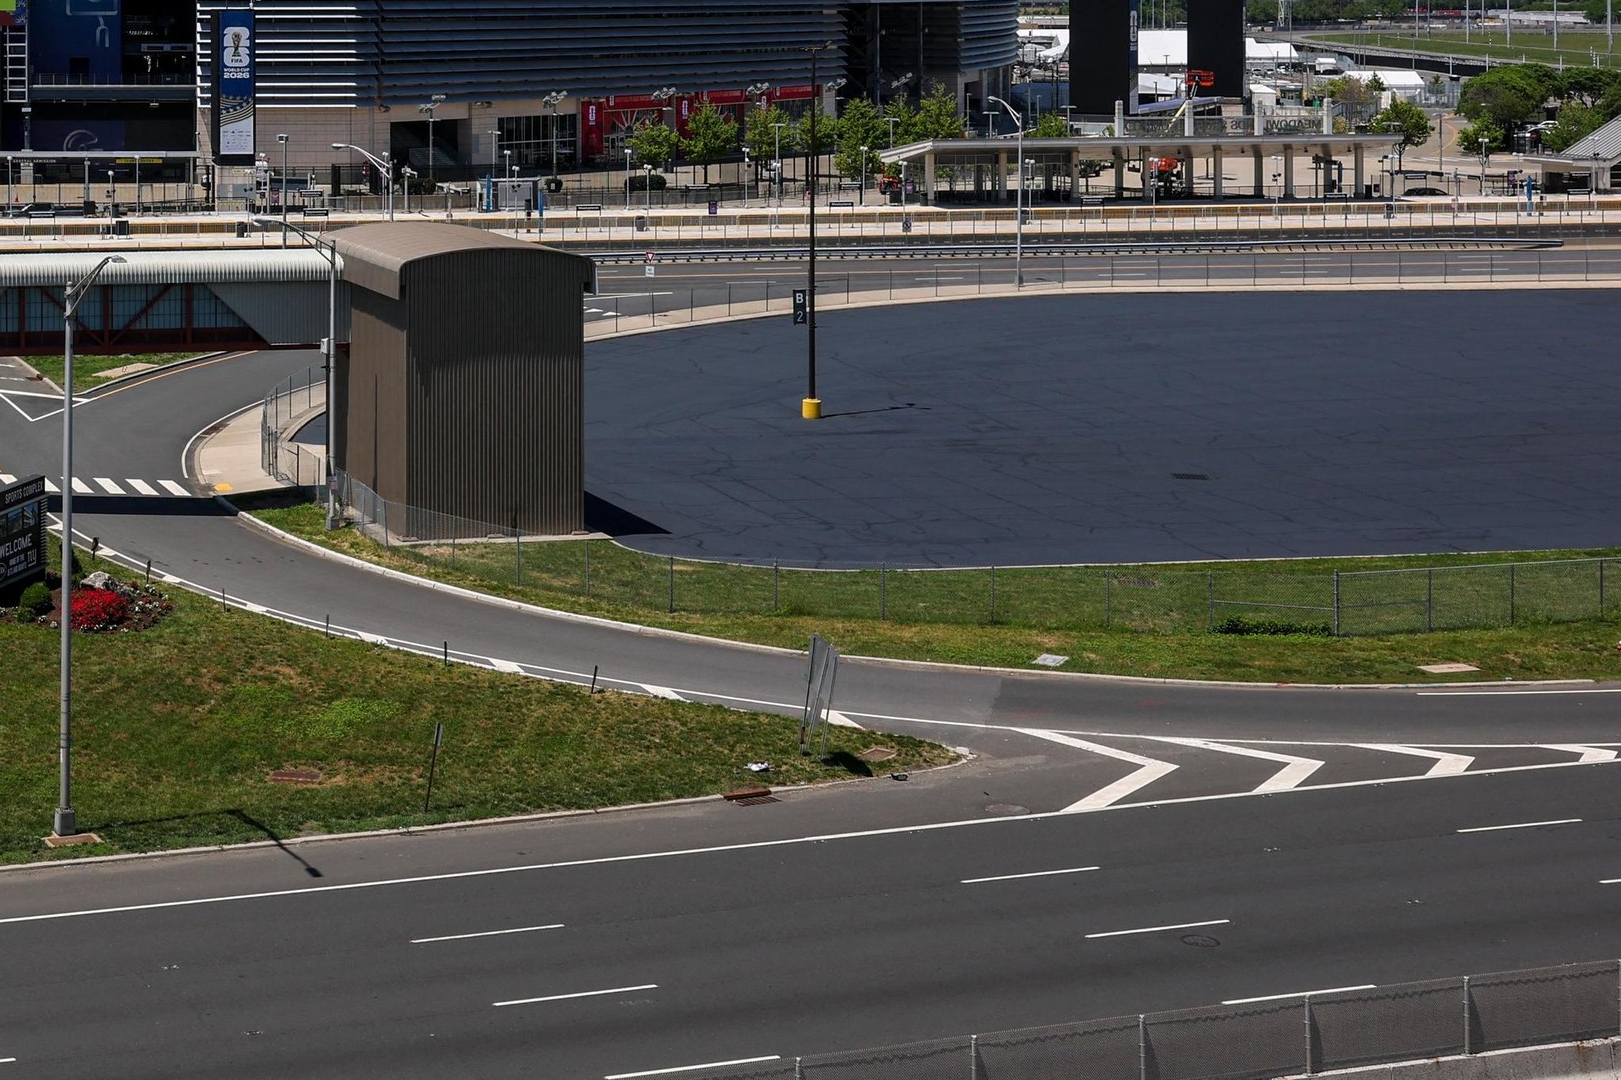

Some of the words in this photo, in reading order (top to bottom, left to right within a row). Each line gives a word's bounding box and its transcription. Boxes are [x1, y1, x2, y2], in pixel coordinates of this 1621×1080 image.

[796, 293, 804, 304] B
[796, 311, 804, 322] 2
[5, 487, 23, 504] SPORTS
[23, 480, 43, 497] COMPLEX
[0, 533, 33, 558] WELCOME
